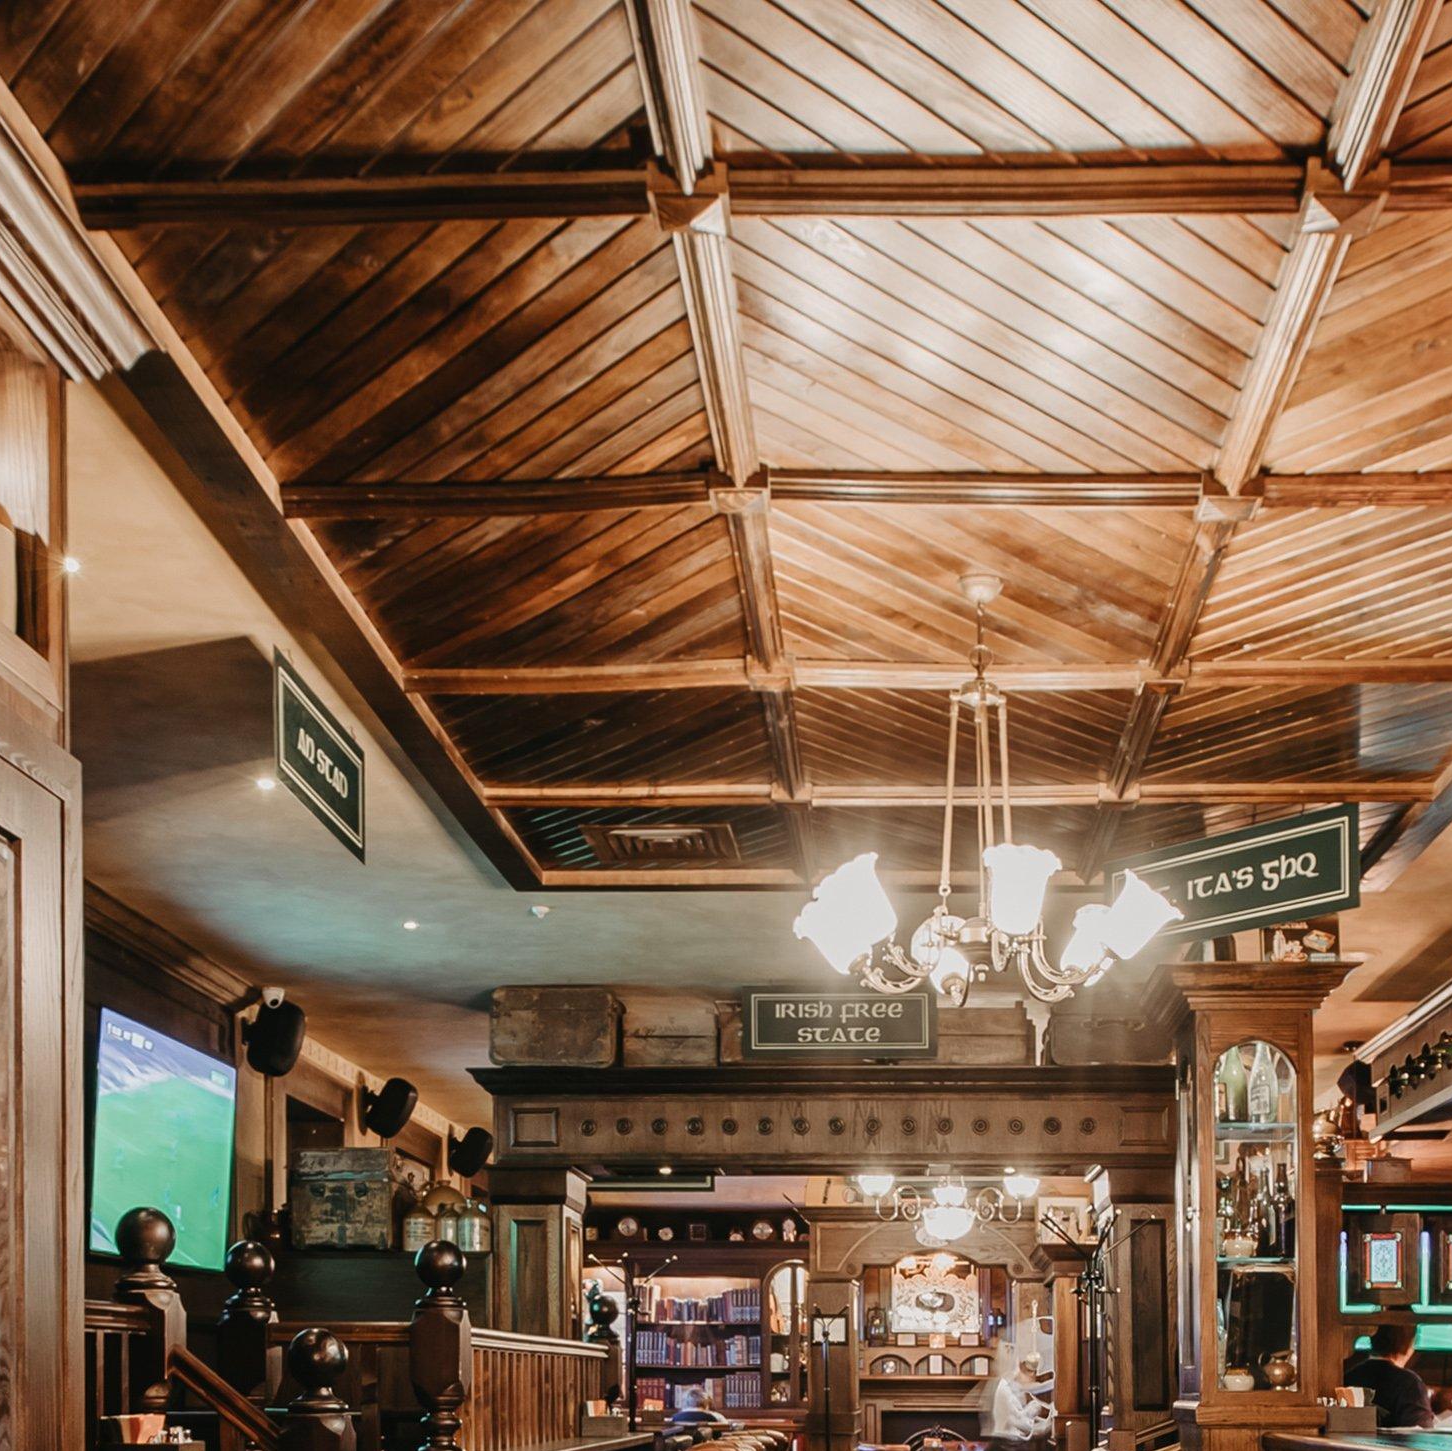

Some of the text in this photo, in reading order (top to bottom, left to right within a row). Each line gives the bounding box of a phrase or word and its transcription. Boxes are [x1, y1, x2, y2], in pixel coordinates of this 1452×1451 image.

[316, 748, 349, 798] STAD
[1186, 865, 1255, 900] ITA'S
[1260, 851, 1320, 892] GHQ
[774, 1000, 904, 1024] IRISH FREE
[797, 1026, 882, 1043] STATE
